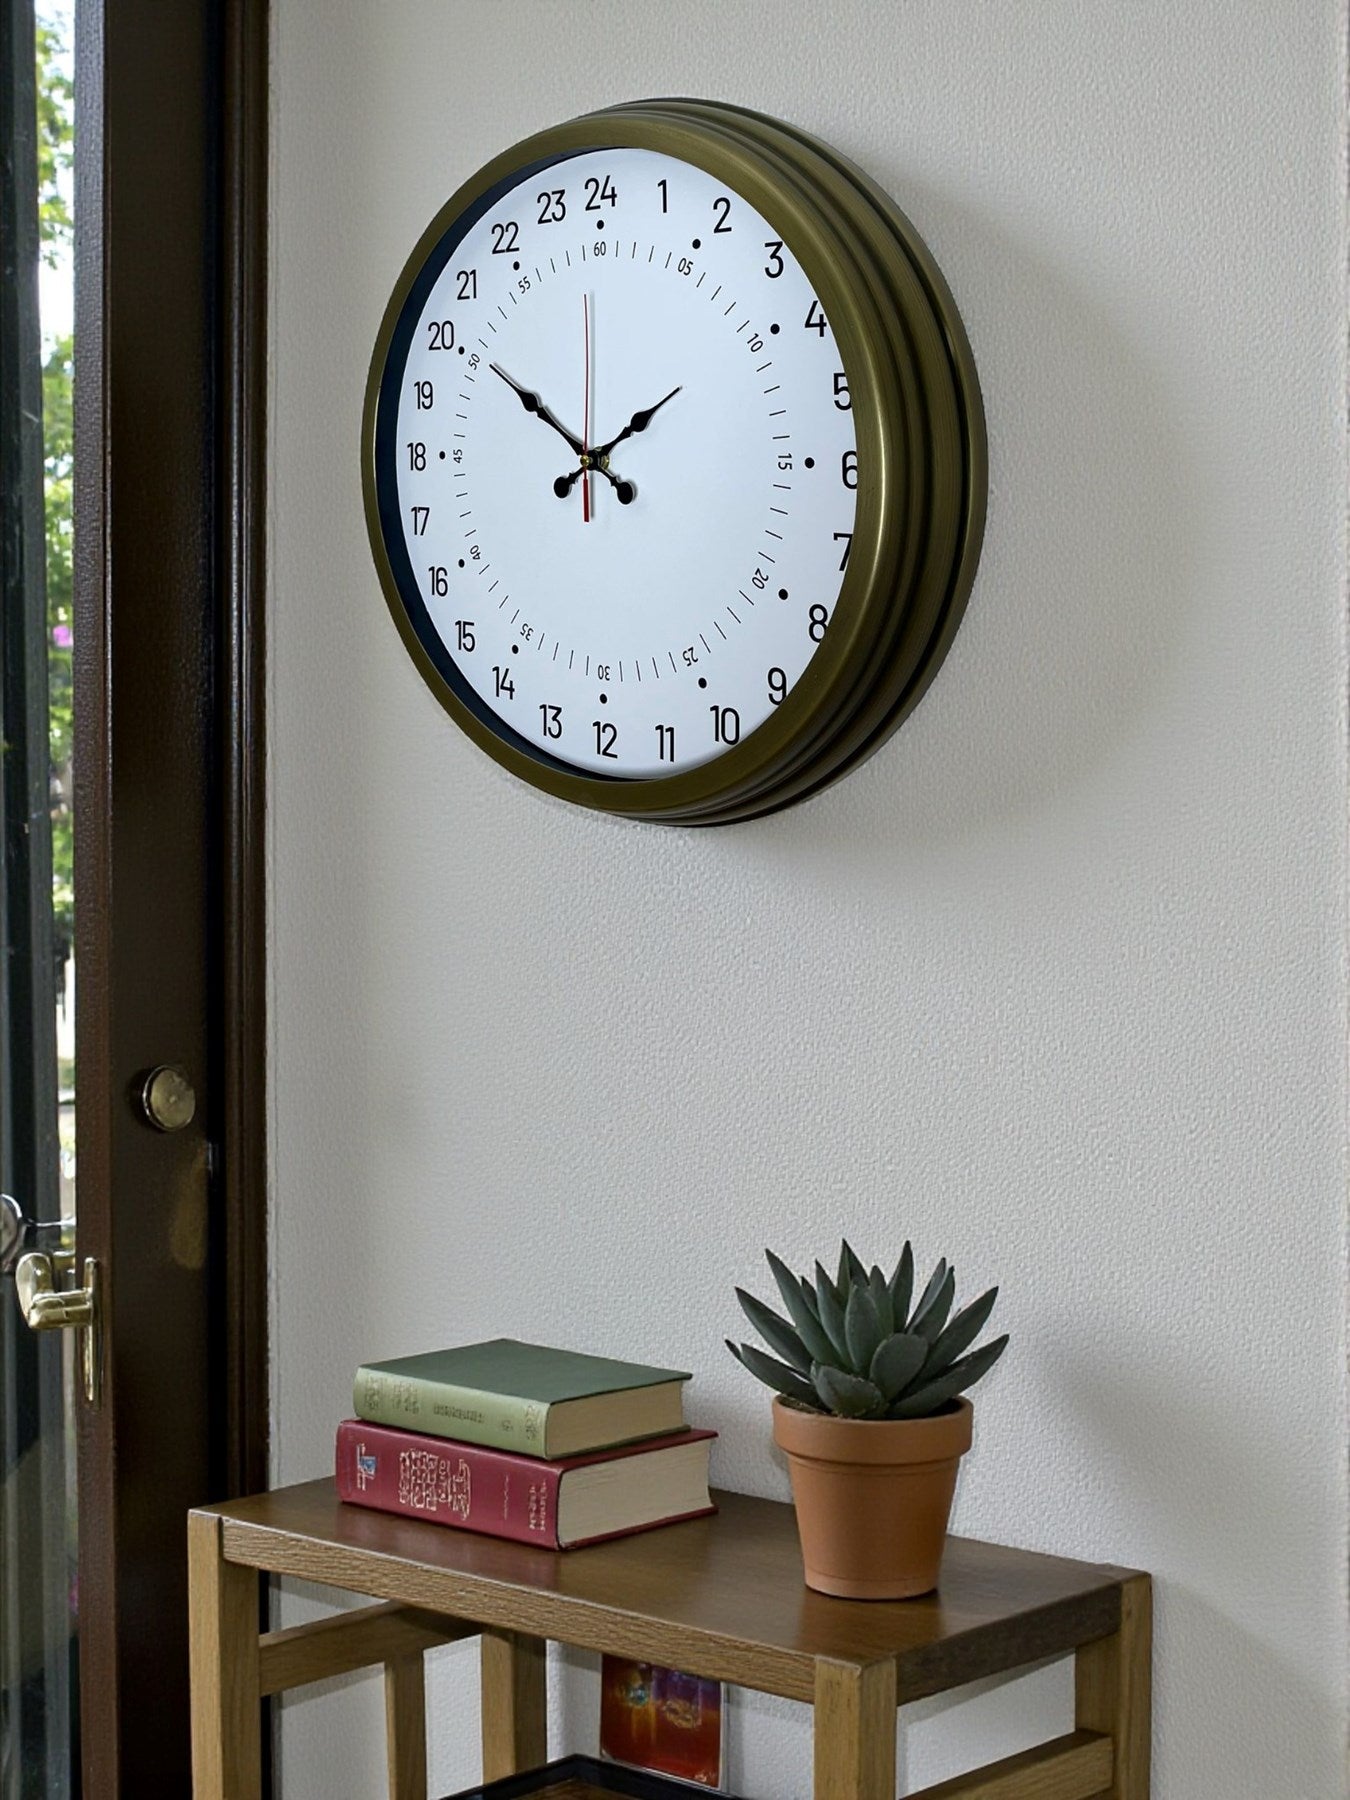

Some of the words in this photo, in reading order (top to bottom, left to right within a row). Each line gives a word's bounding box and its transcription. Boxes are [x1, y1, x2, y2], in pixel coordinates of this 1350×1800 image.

[537, 189, 566, 224] 23
[584, 175, 617, 211] 24
[657, 179, 668, 213] 1
[713, 197, 732, 233] 2
[491, 221, 519, 254] 22
[593, 241, 606, 256] 60
[678, 257, 694, 276] 05
[764, 241, 784, 278] 3
[456, 269, 477, 300] 21
[518, 276, 531, 294] 55
[804, 300, 827, 337] 4
[428, 320, 455, 351] 20
[747, 333, 764, 353] 10
[468, 353, 481, 370] 50
[413, 380, 434, 410] 19
[833, 372, 852, 410] 5
[406, 442, 426, 471] 18
[452, 448, 463, 464] 45
[777, 452, 792, 471] 15
[841, 450, 858, 489] 6
[411, 506, 430, 536] 17
[469, 544, 481, 561] 40
[833, 532, 853, 571] 7
[428, 566, 448, 597] 16
[751, 568, 769, 590] 20
[455, 620, 476, 652] 15
[520, 622, 534, 641] 35
[808, 604, 828, 642] 8
[682, 646, 699, 667] 25
[492, 666, 516, 700] 14
[597, 664, 611, 681] 30
[767, 667, 787, 705] 9
[539, 704, 563, 739] 13
[709, 705, 740, 746] 10
[592, 721, 618, 759] 12
[655, 724, 675, 763] 11
